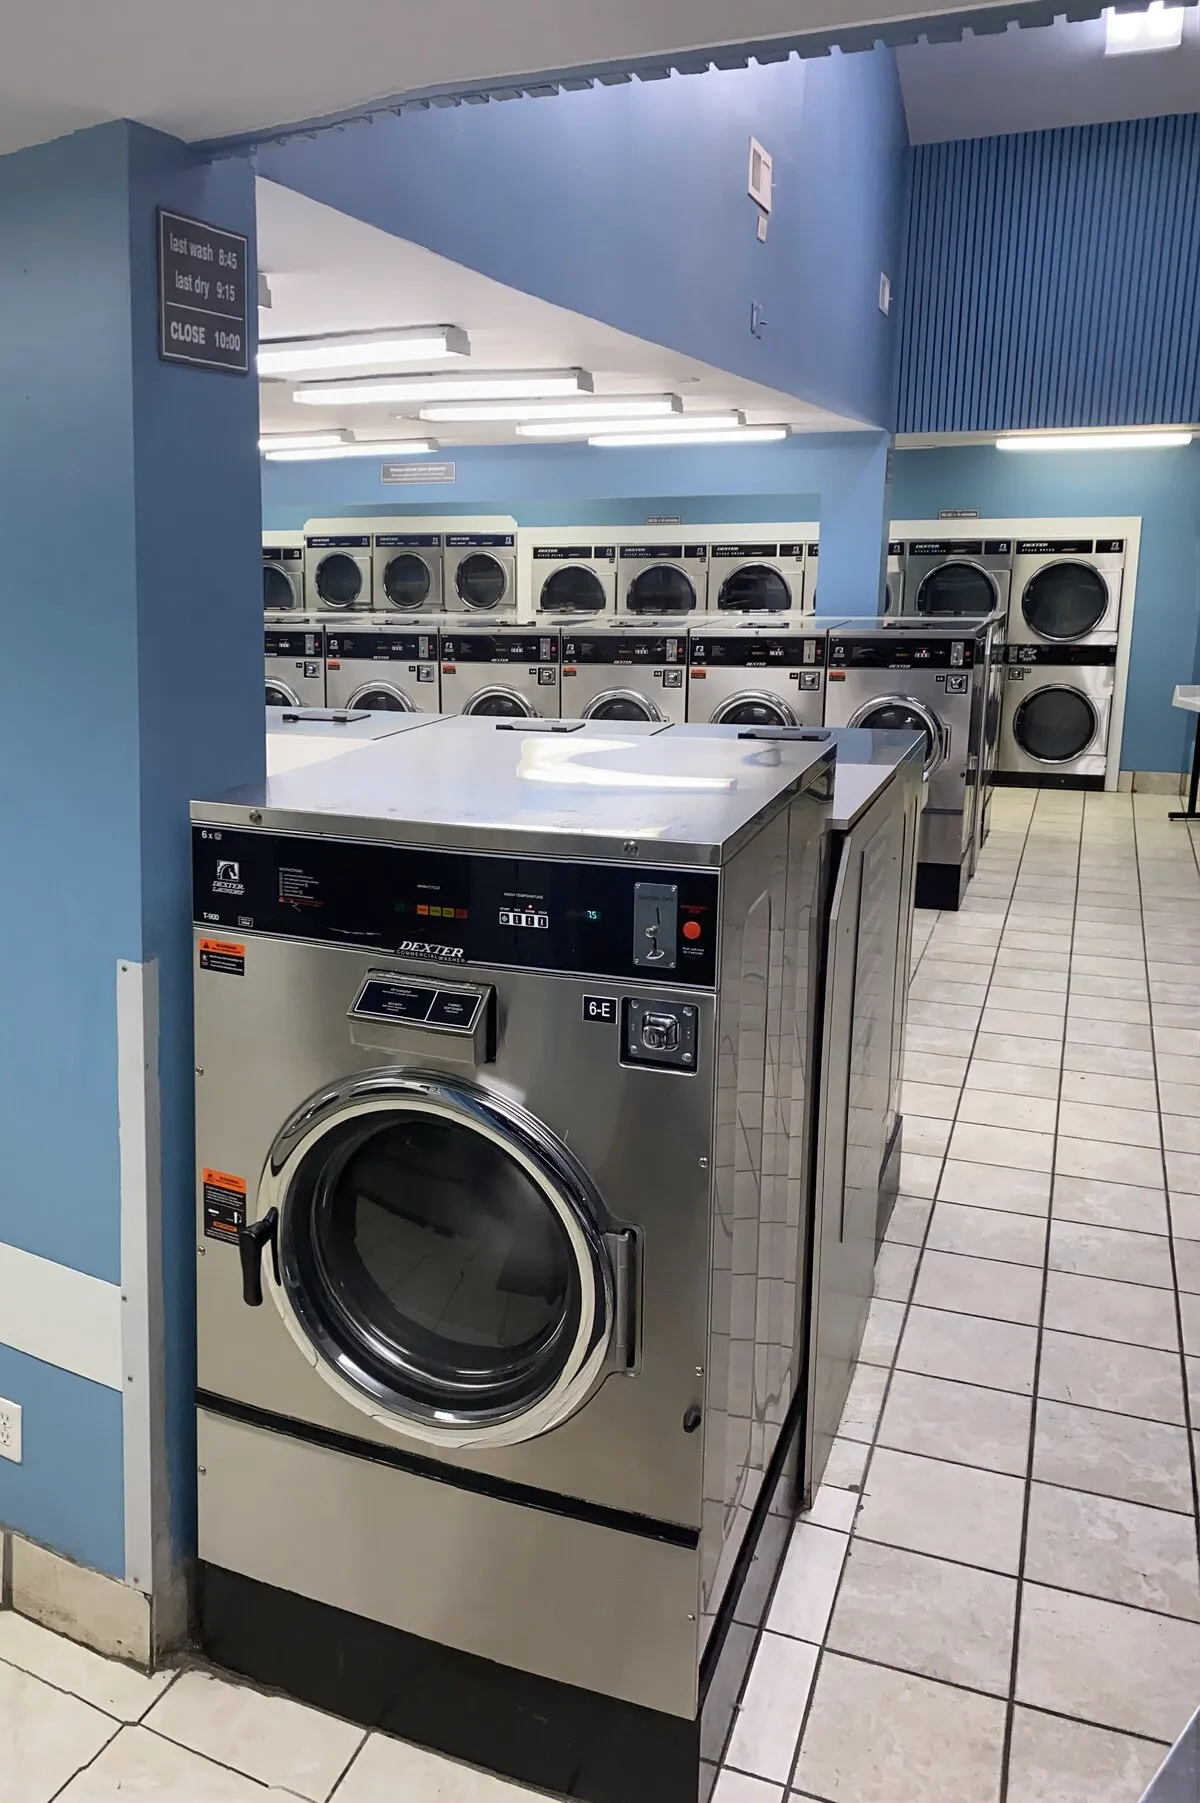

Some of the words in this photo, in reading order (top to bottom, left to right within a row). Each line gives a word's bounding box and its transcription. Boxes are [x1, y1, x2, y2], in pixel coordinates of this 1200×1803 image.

[170, 233, 187, 255] last
[189, 243, 213, 262] wash
[218, 249, 237, 269] 8:45
[175, 270, 192, 292] last
[195, 276, 210, 299] dry
[216, 281, 235, 301] 9:15
[170, 321, 206, 344] CLOSE
[214, 330, 240, 351] 10:00
[201, 830, 207, 839] 6
[212, 880, 245, 890] DEXTER
[212, 887, 245, 896] LAUNDRY
[203, 912, 220, 921] T-900
[396, 949, 437, 959] COMMERCIAL
[399, 941, 464, 957] DEXTER
[589, 1001, 610, 1017] 6-E
